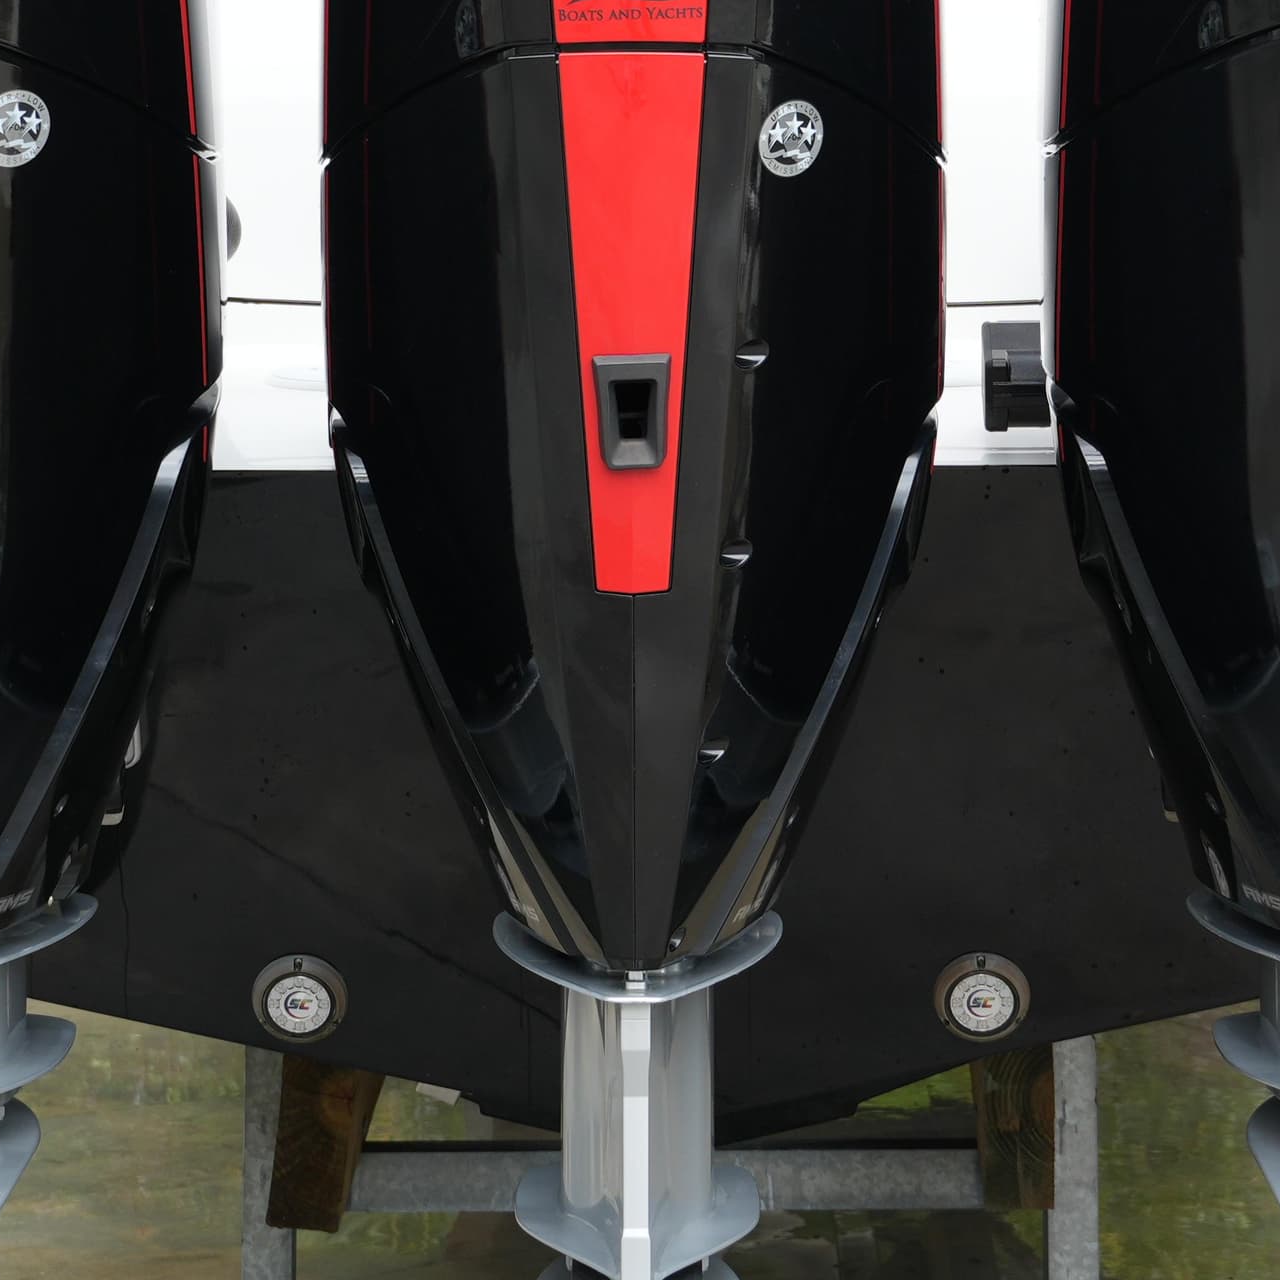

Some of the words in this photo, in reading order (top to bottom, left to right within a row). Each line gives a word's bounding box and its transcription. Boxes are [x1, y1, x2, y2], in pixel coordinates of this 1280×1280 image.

[558, 9, 603, 21] BOATS
[609, 9, 641, 20] AND
[646, 7, 703, 19] YACHTS
